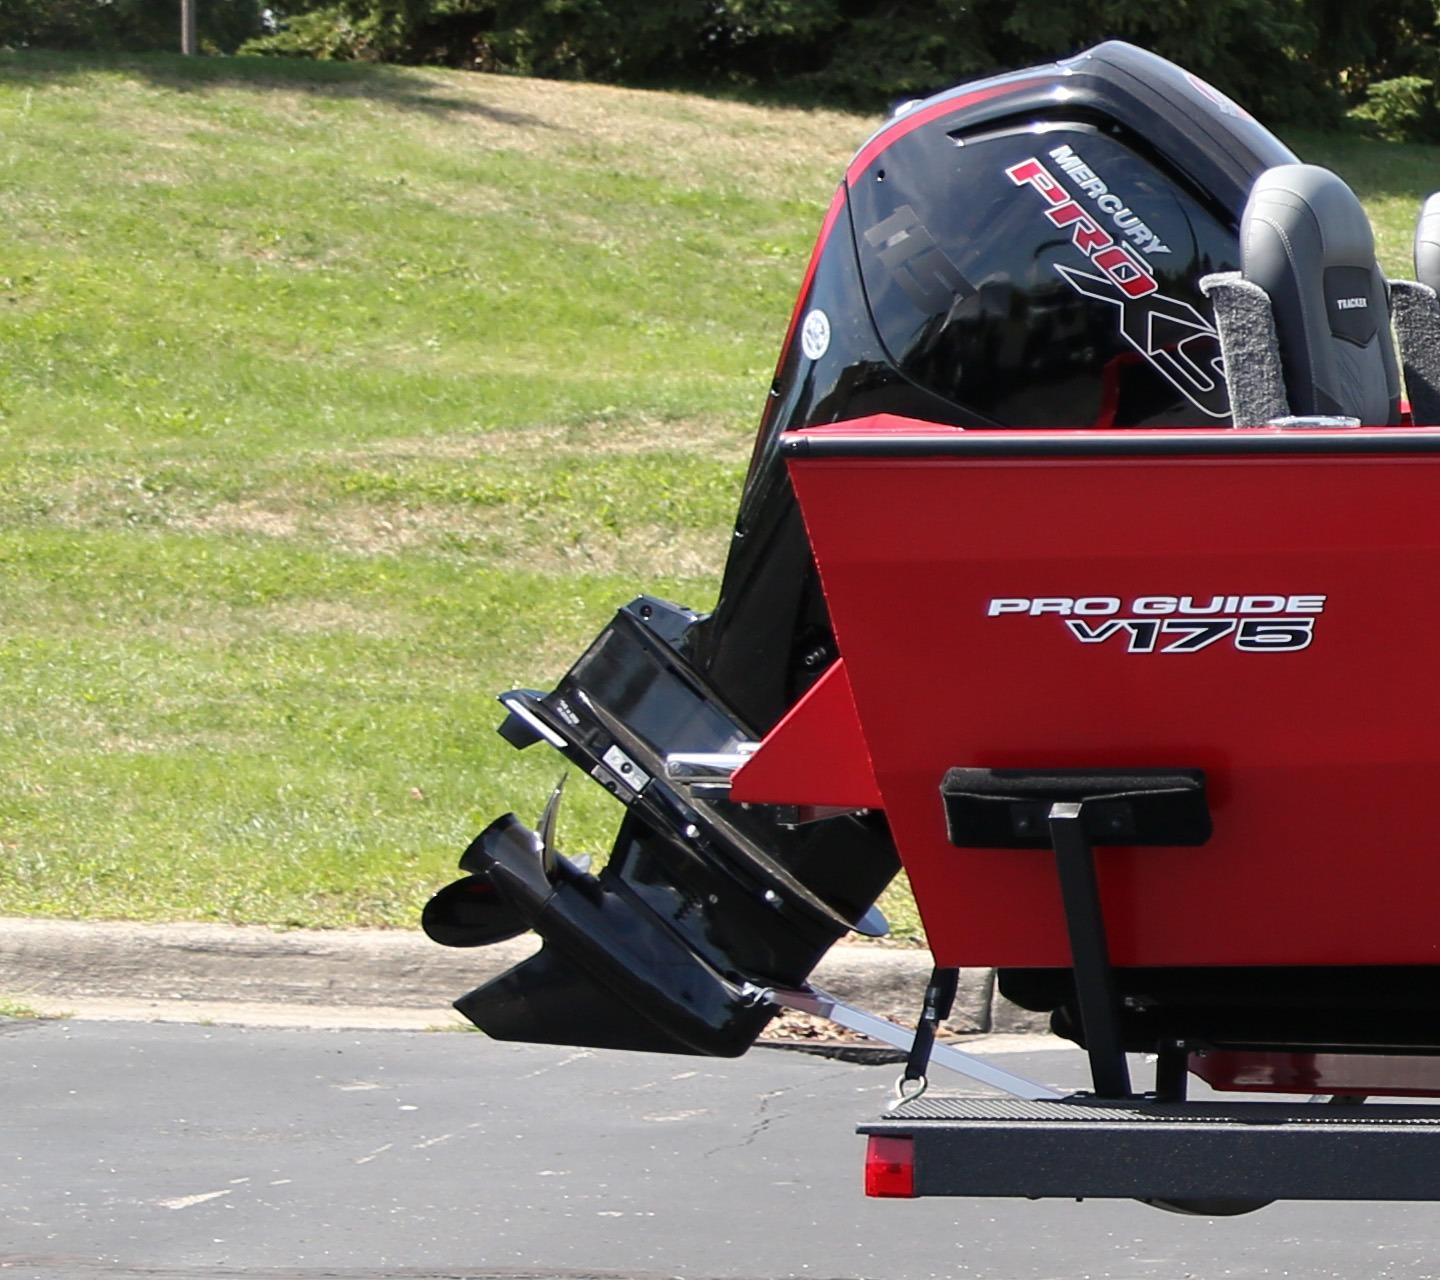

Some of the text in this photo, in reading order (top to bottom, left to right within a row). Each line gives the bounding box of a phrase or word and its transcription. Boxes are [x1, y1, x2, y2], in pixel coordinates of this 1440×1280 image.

[1005, 157, 1158, 299] PRO
[1049, 144, 1172, 255] MERCURY
[988, 595, 1327, 616] PRO GUIDE
